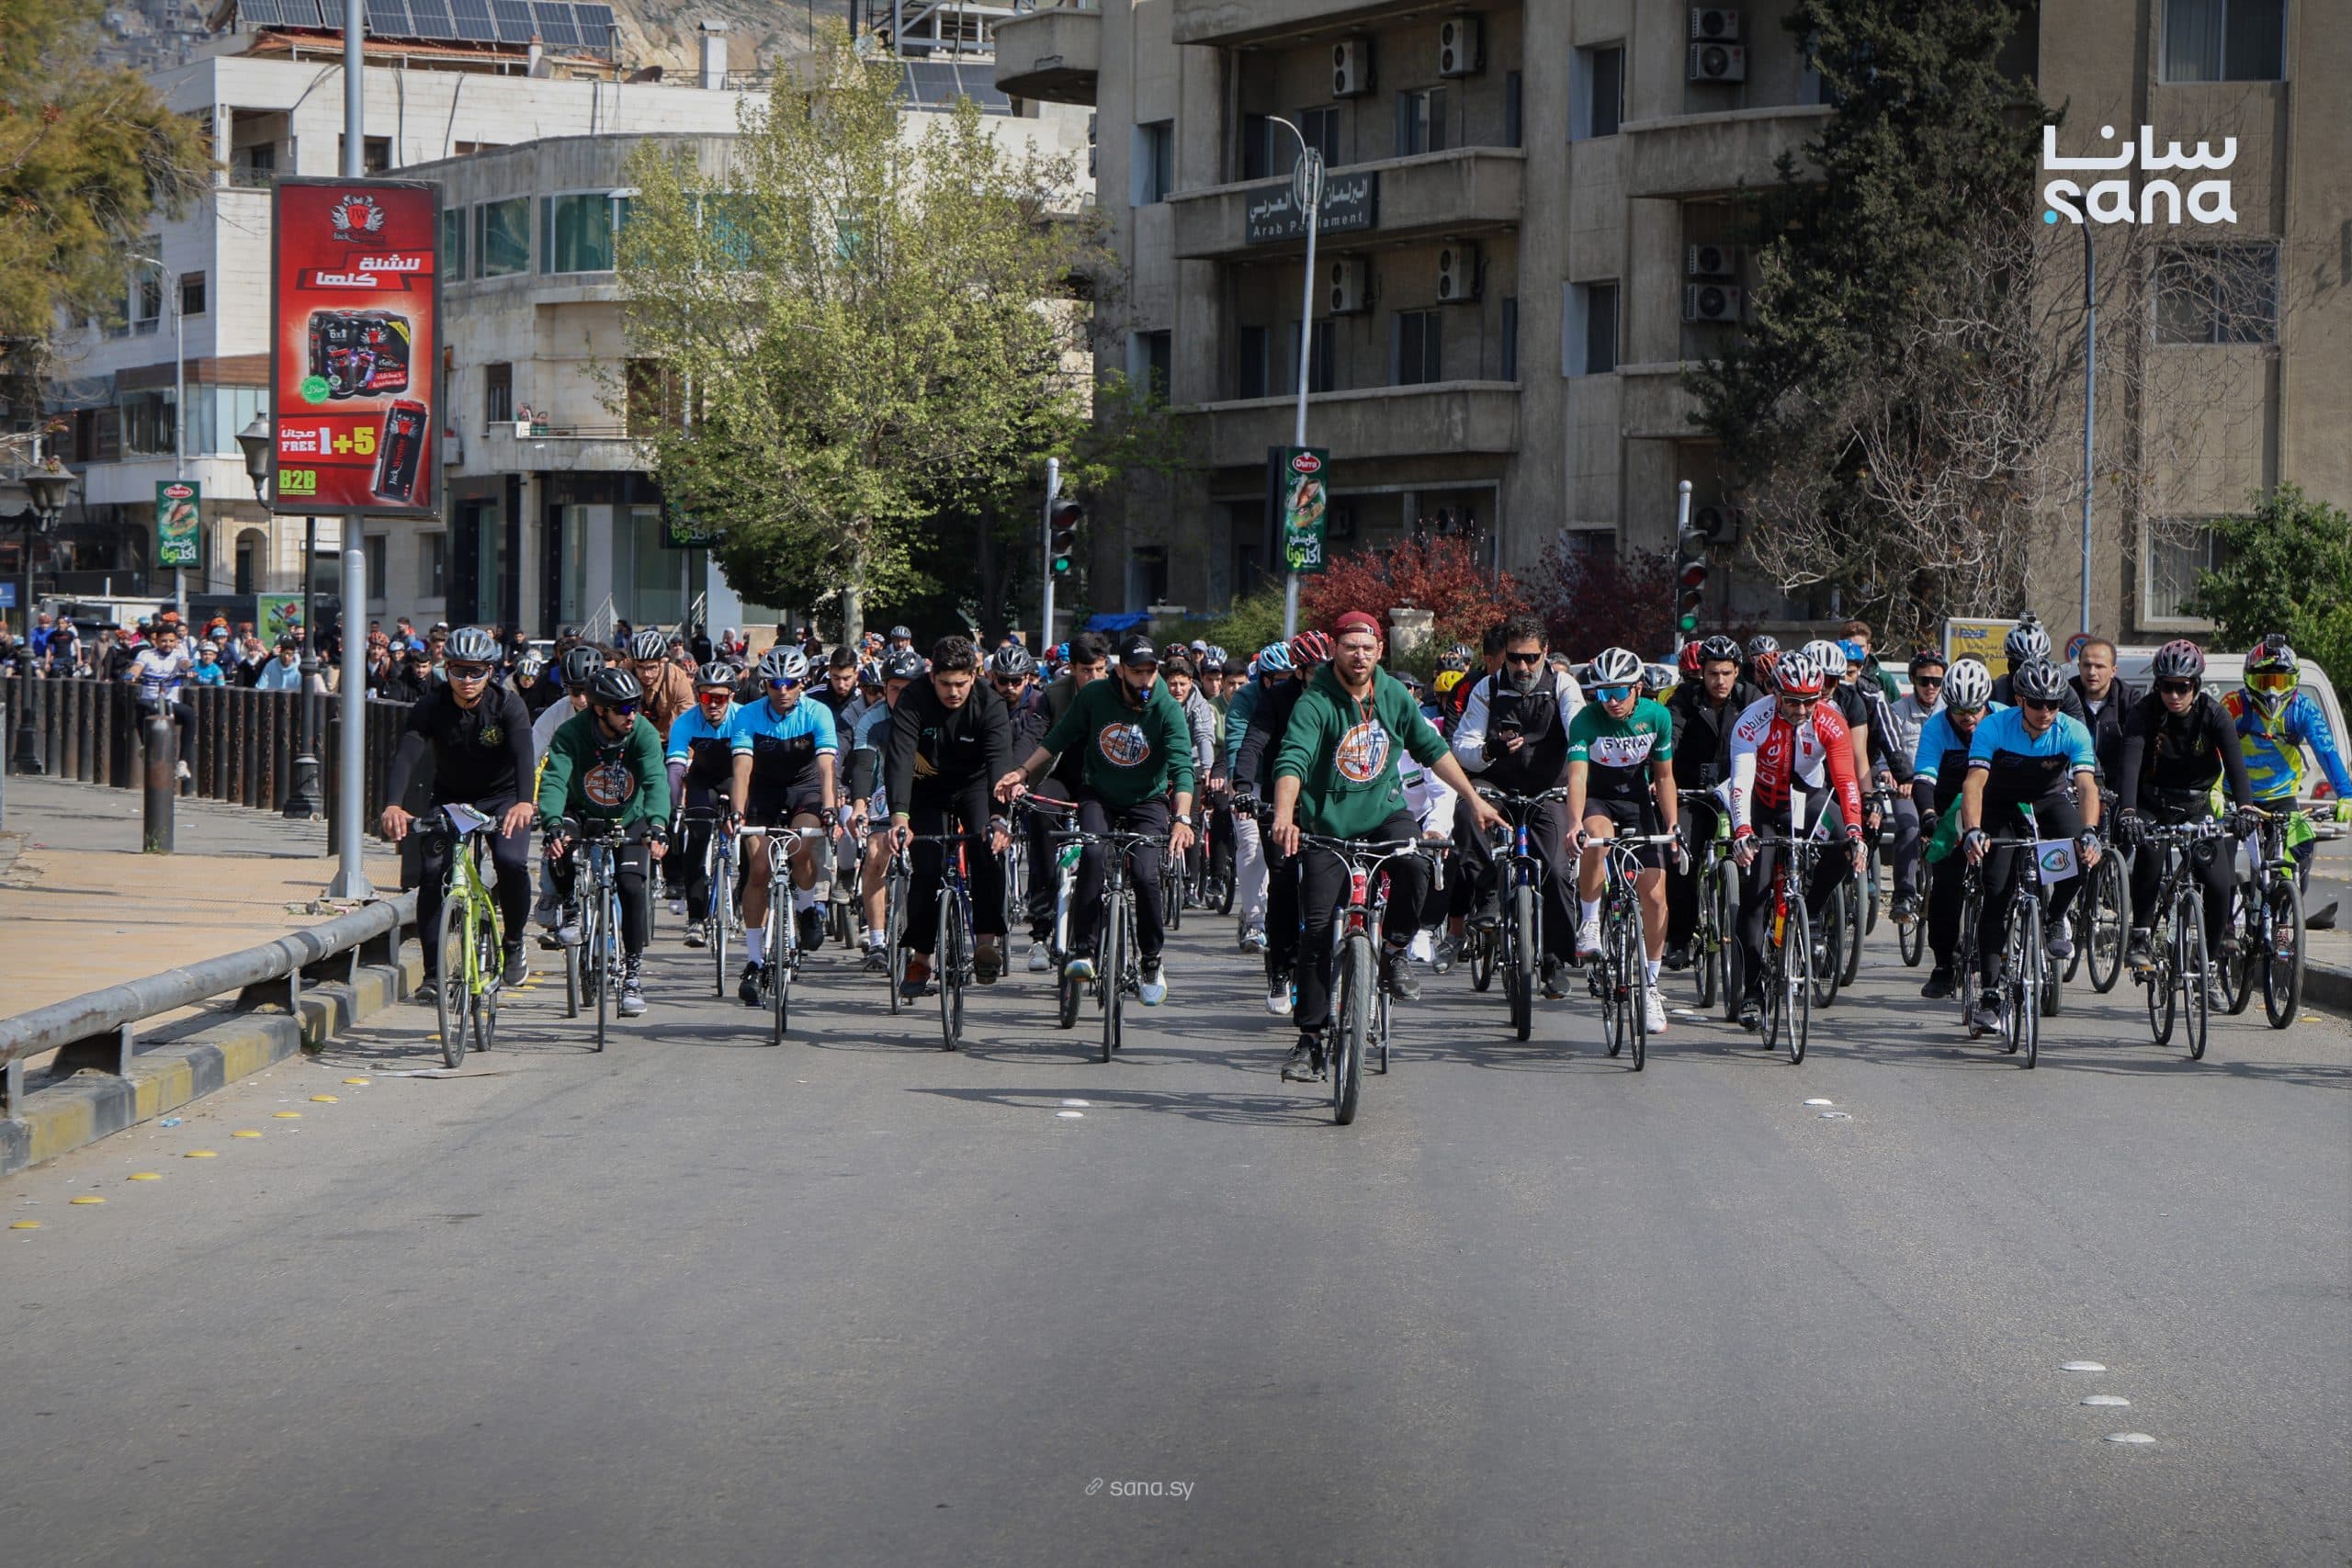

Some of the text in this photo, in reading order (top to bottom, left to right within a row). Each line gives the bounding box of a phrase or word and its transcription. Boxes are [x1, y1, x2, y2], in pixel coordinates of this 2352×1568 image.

[1250, 178, 1368, 223] البرلمان العربي
[1253, 222, 1283, 237] Arab
[358, 254, 421, 271] للشلة
[315, 272, 378, 287] كلها
[281, 440, 317, 452] FREE
[1295, 458, 1317, 468] Durra
[278, 469, 317, 490] B2B
[1604, 739, 1647, 751] SYRIA
